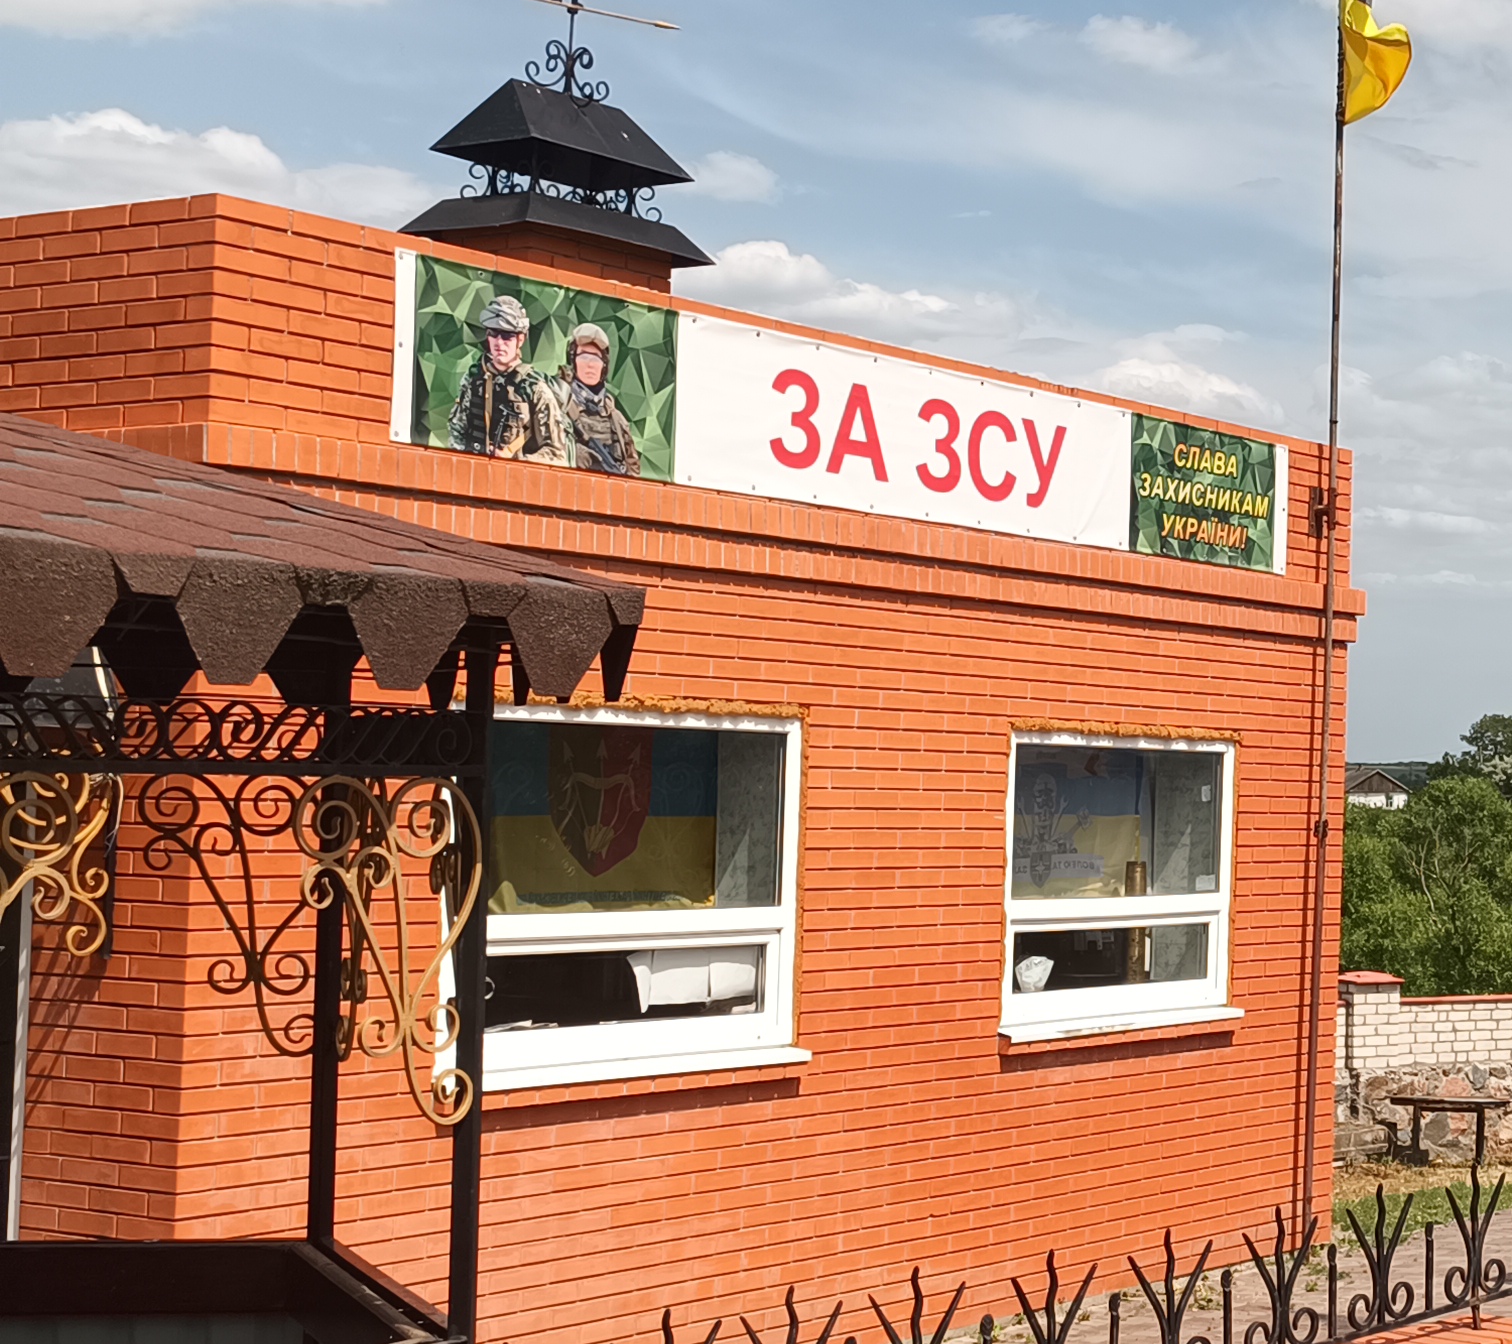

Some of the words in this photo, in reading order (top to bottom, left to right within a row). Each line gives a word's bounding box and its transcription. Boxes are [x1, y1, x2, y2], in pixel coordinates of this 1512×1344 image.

[769, 368, 889, 483] ЗА
[915, 398, 1067, 508] ЗСУ
[1173, 443, 1238, 479] СЛАВА
[1138, 472, 1270, 519] ЗАХИСНИКАМ
[1161, 513, 1249, 550] УКРАЇНИ!
